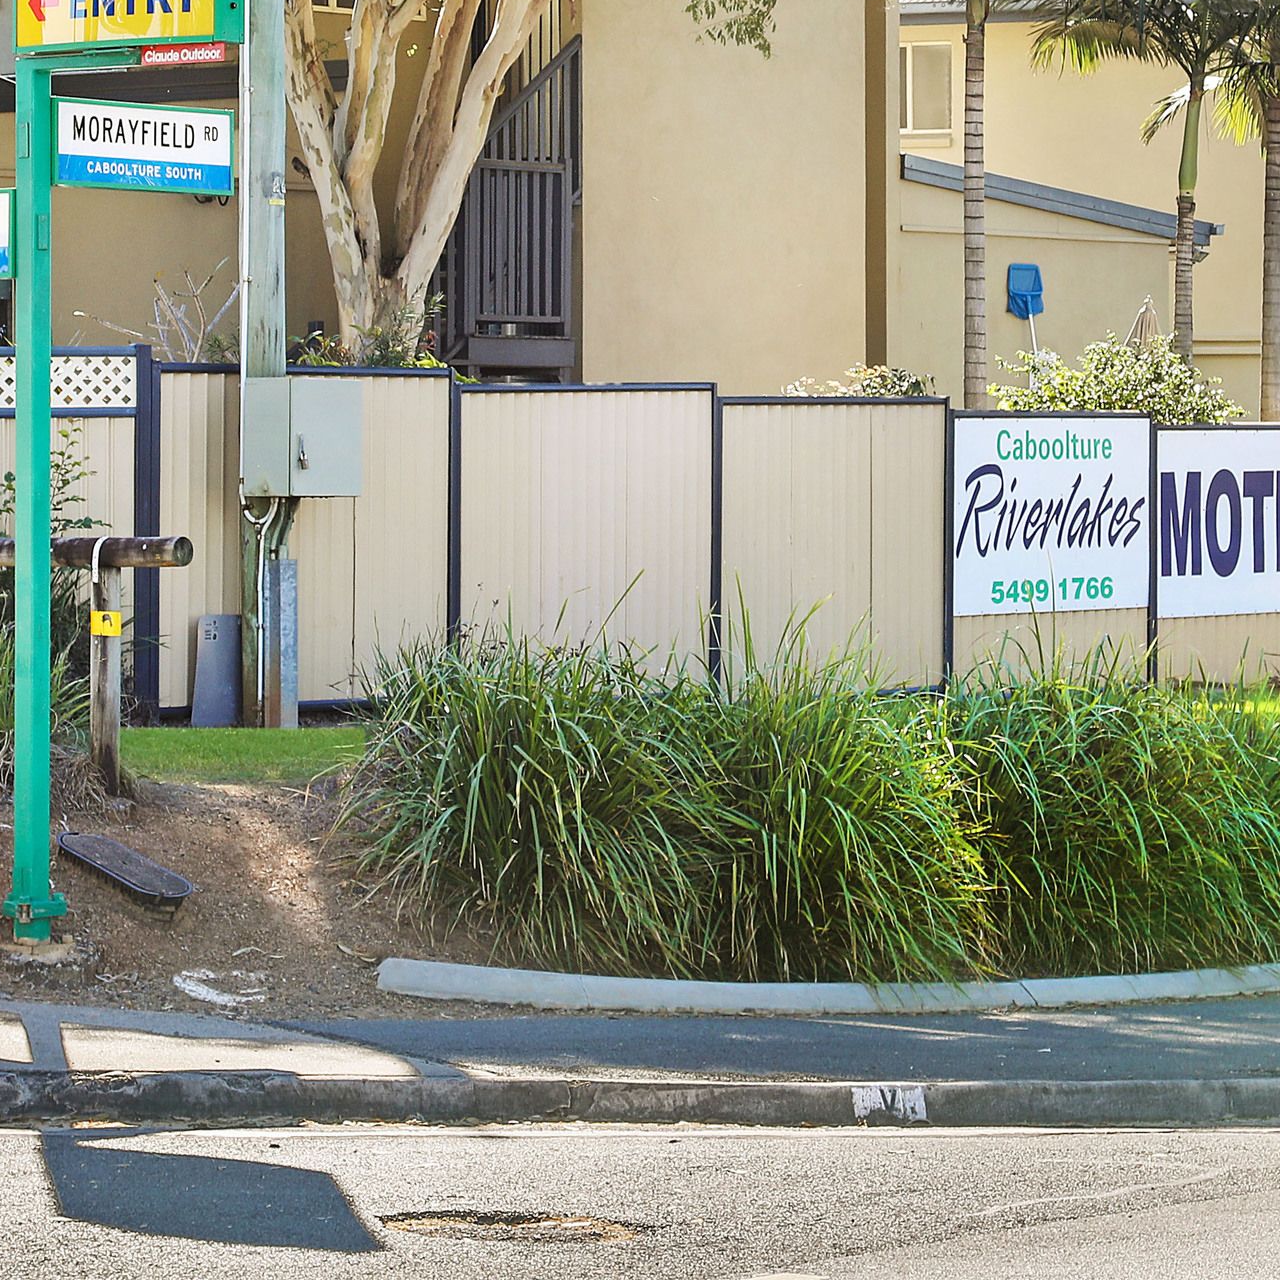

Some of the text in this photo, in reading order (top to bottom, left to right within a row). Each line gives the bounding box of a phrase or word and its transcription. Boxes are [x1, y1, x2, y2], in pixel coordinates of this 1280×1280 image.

[145, 50, 179, 63] Claude
[72, 115, 219, 149] MORAYFIELD RD
[86, 161, 202, 181] CABOOLTURE SOUTH
[997, 429, 1112, 461] Caboolture
[956, 463, 1145, 558] Riverlakes
[991, 576, 1113, 604] 5499 1766
